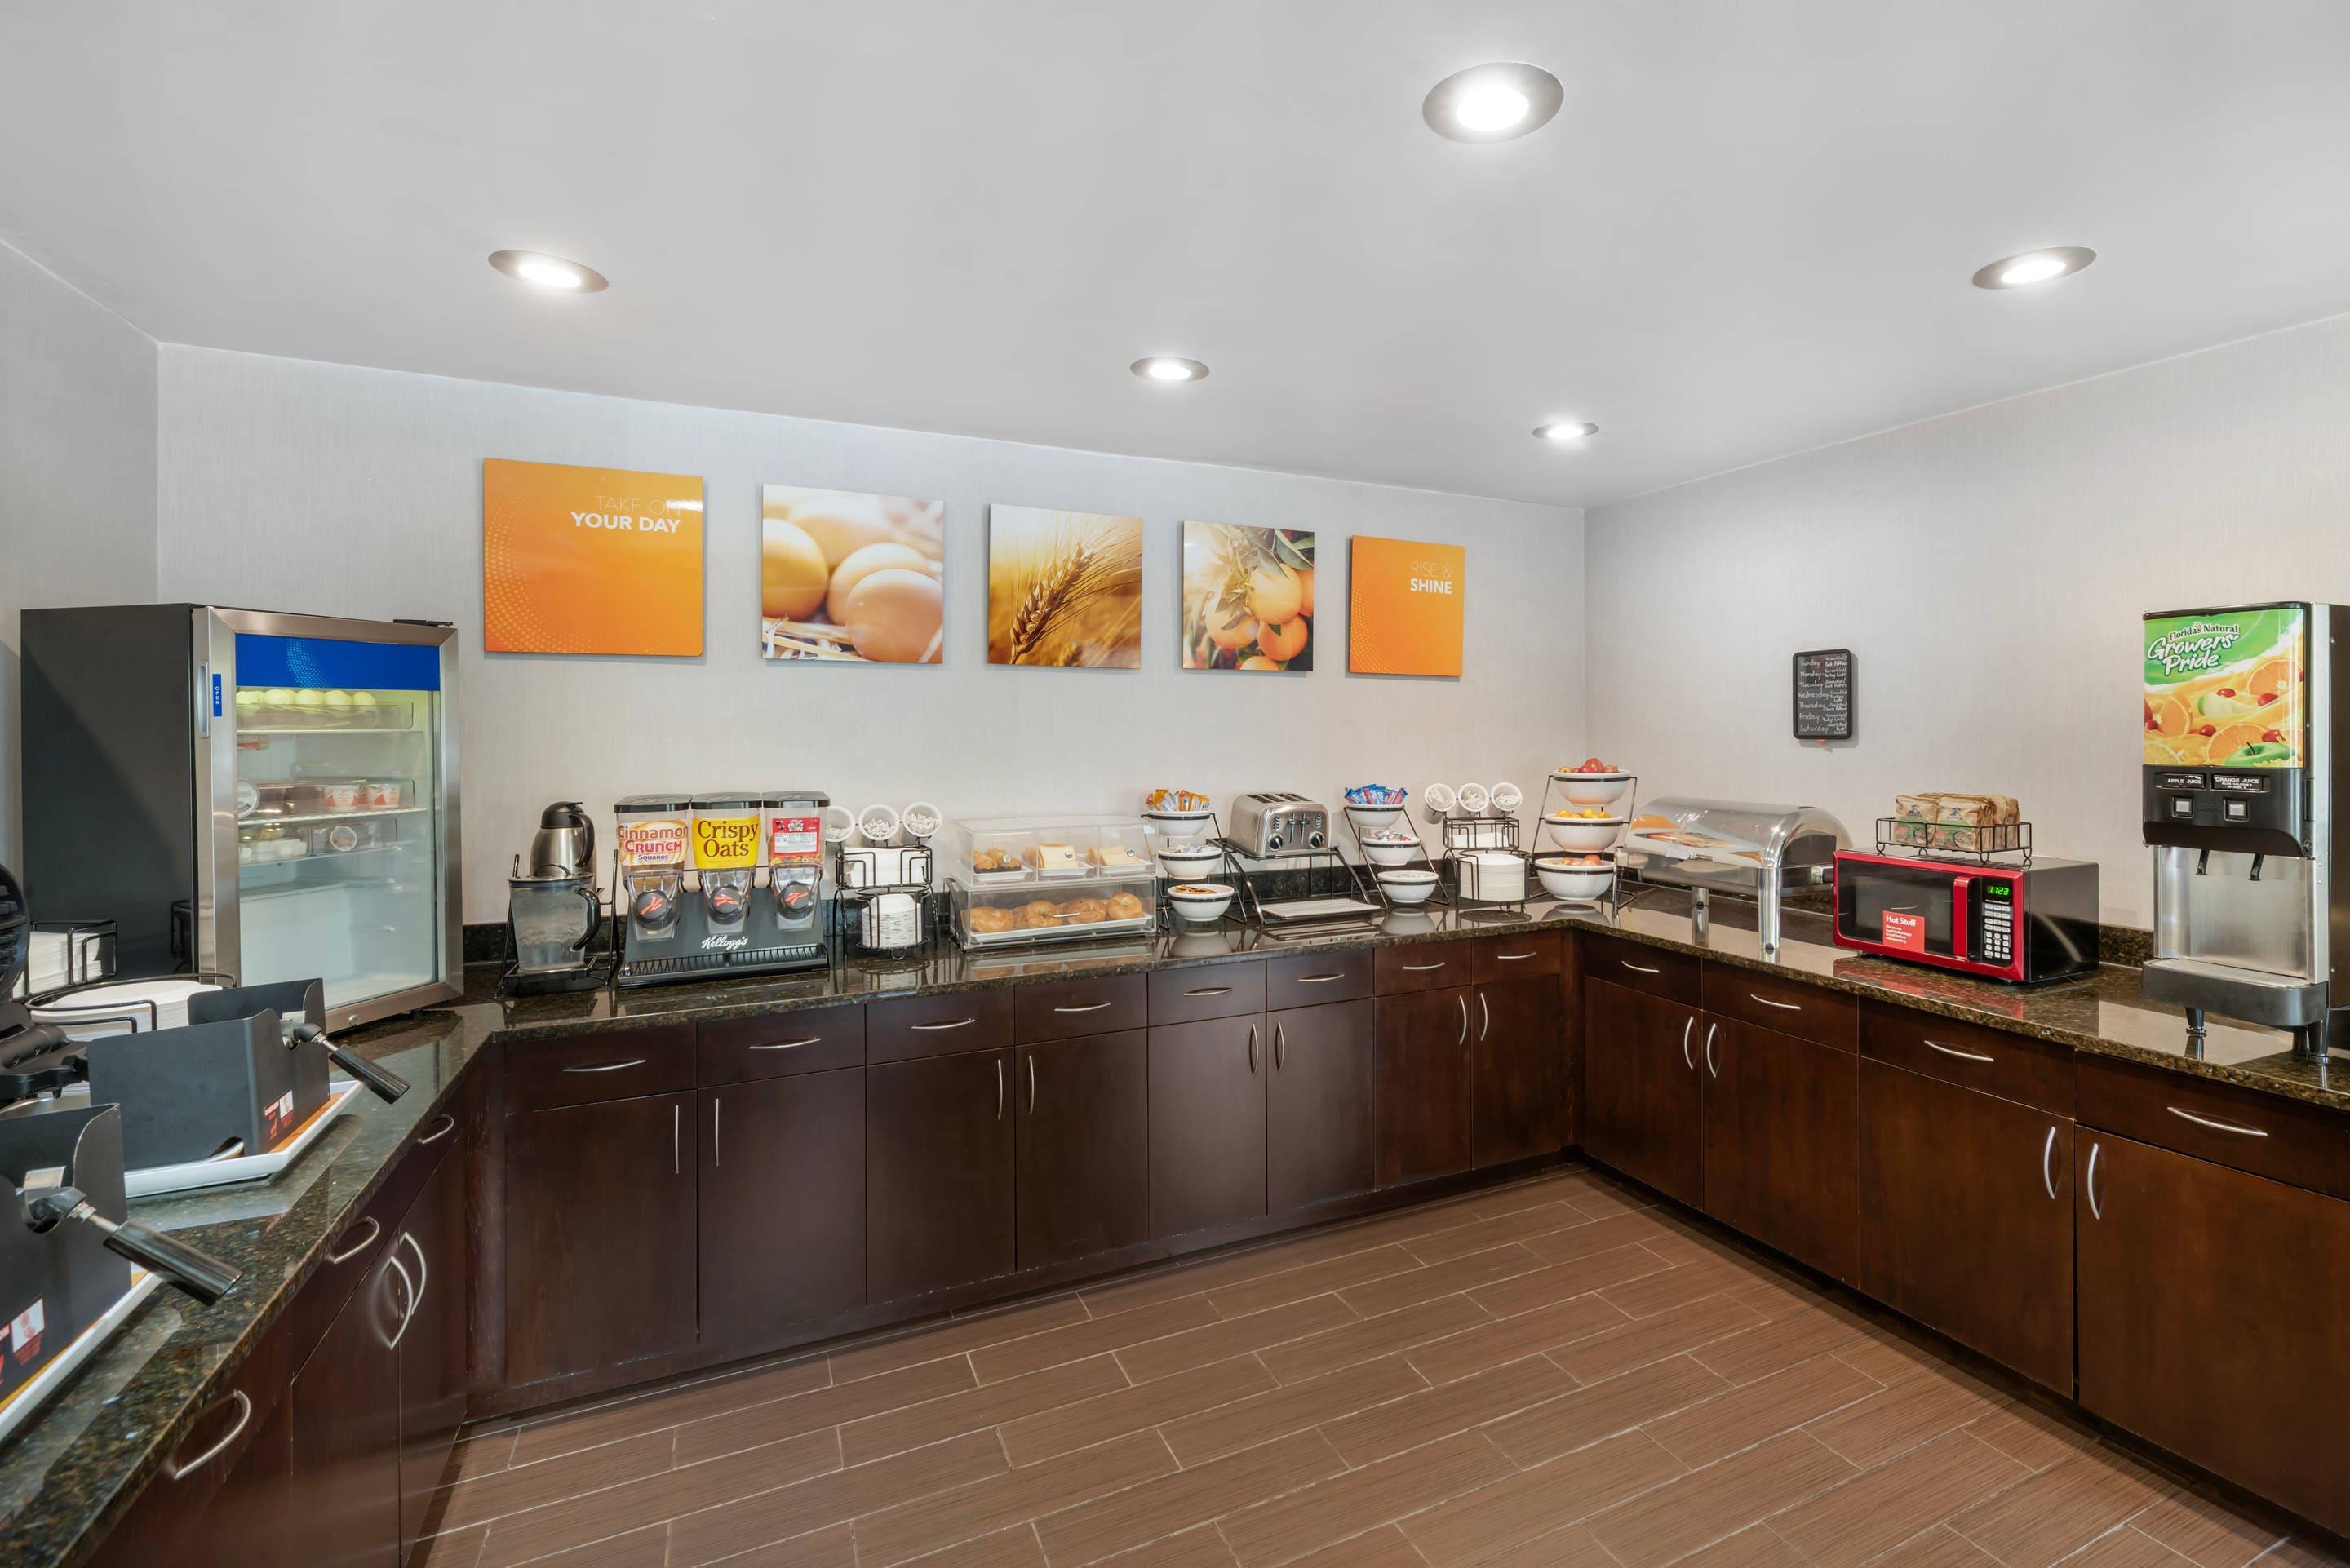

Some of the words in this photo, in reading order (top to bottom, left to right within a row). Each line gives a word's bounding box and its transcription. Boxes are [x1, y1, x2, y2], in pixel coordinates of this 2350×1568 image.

[594, 495, 641, 513] TAKE
[570, 512, 632, 530] YOUR
[639, 516, 681, 534] DAY
[1410, 560, 1438, 578] RISE
[1442, 564, 1452, 579] &
[1410, 578, 1453, 595] SHINE
[2203, 624, 2238, 633] Natural
[2162, 649, 2219, 675] Pride
[1799, 712, 1820, 724] Friday
[698, 820, 759, 842] Crispy
[703, 839, 749, 857] Oats
[1886, 915, 1899, 924] Hot
[1900, 918, 1917, 927] Stuff
[701, 934, 748, 950] Kellogg's
